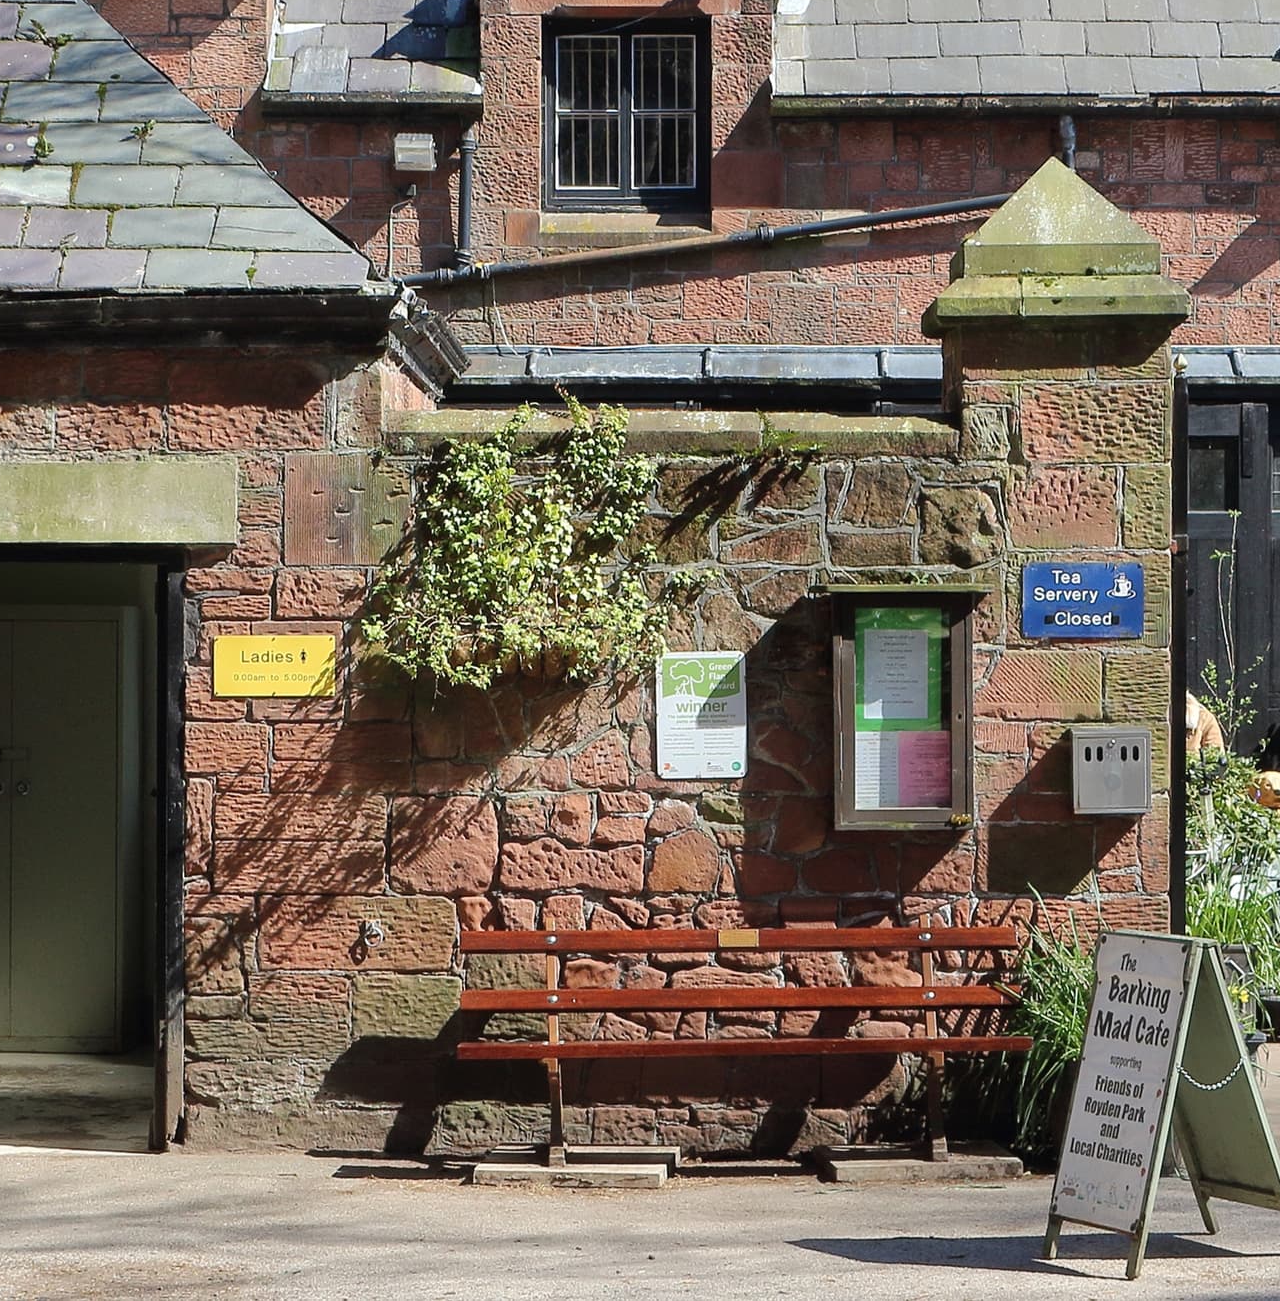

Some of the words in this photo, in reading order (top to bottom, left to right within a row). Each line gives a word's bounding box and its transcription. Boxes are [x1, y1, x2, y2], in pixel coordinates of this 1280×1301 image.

[1052, 570, 1080, 584] Tea
[1034, 588, 1098, 604] Servery
[1054, 612, 1112, 625] Closed
[241, 650, 294, 663] Ladies
[708, 662, 733, 671] Green
[676, 700, 728, 712] winner
[1120, 953, 1137, 972] The
[1108, 974, 1171, 1014] Barking
[1094, 1010, 1133, 1042] Mad
[1136, 1016, 1170, 1047] Cafe
[1110, 1055, 1142, 1072] supporting
[1095, 1075, 1131, 1097] Friends
[1133, 1082, 1144, 1099] of
[1084, 1096, 1121, 1120] Royden
[1122, 1104, 1146, 1123] Park
[1100, 1123, 1120, 1139] and
[1070, 1138, 1096, 1157] Local
[1096, 1143, 1143, 1167] Charities
